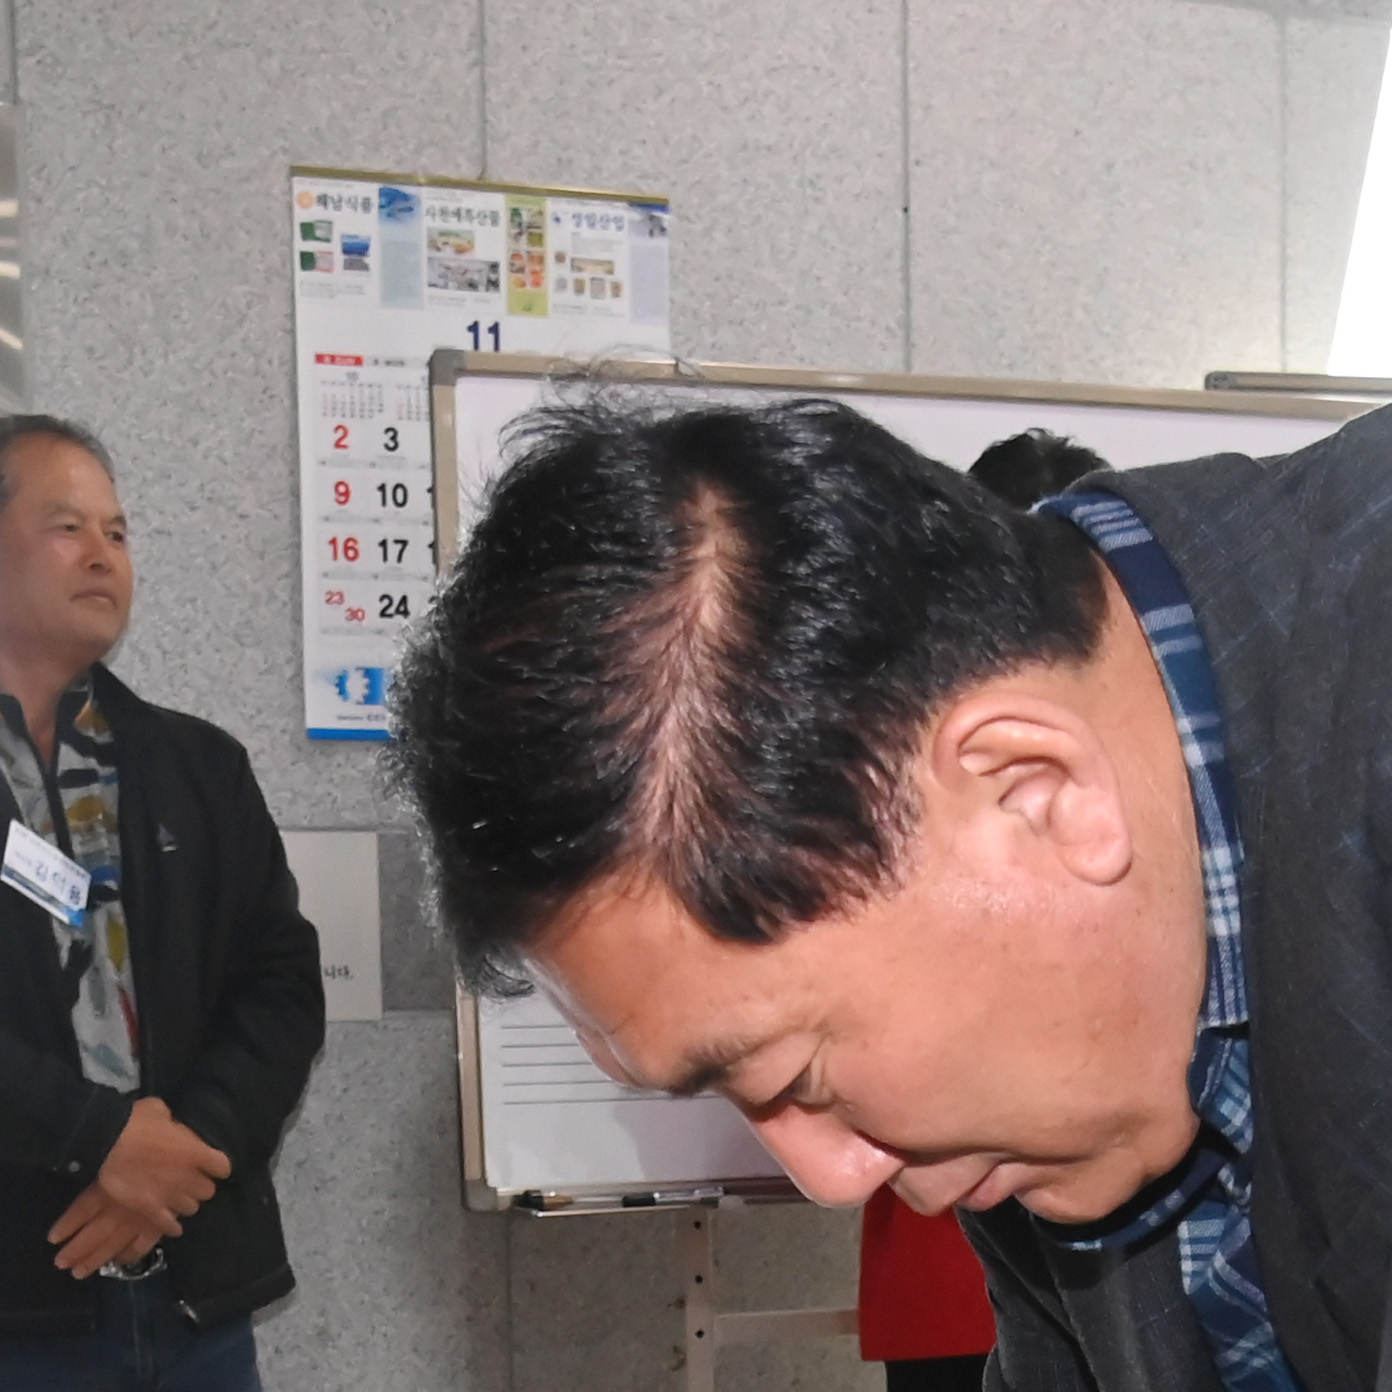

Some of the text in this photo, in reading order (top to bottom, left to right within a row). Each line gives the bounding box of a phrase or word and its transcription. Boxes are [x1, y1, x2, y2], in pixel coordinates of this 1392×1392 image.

[466, 320, 502, 351] 11
[333, 424, 400, 452] 2 3
[333, 480, 409, 508] 9 10
[327, 536, 410, 564] 16 17
[324, 590, 410, 620] 23 24
[344, 607, 366, 622] 30
